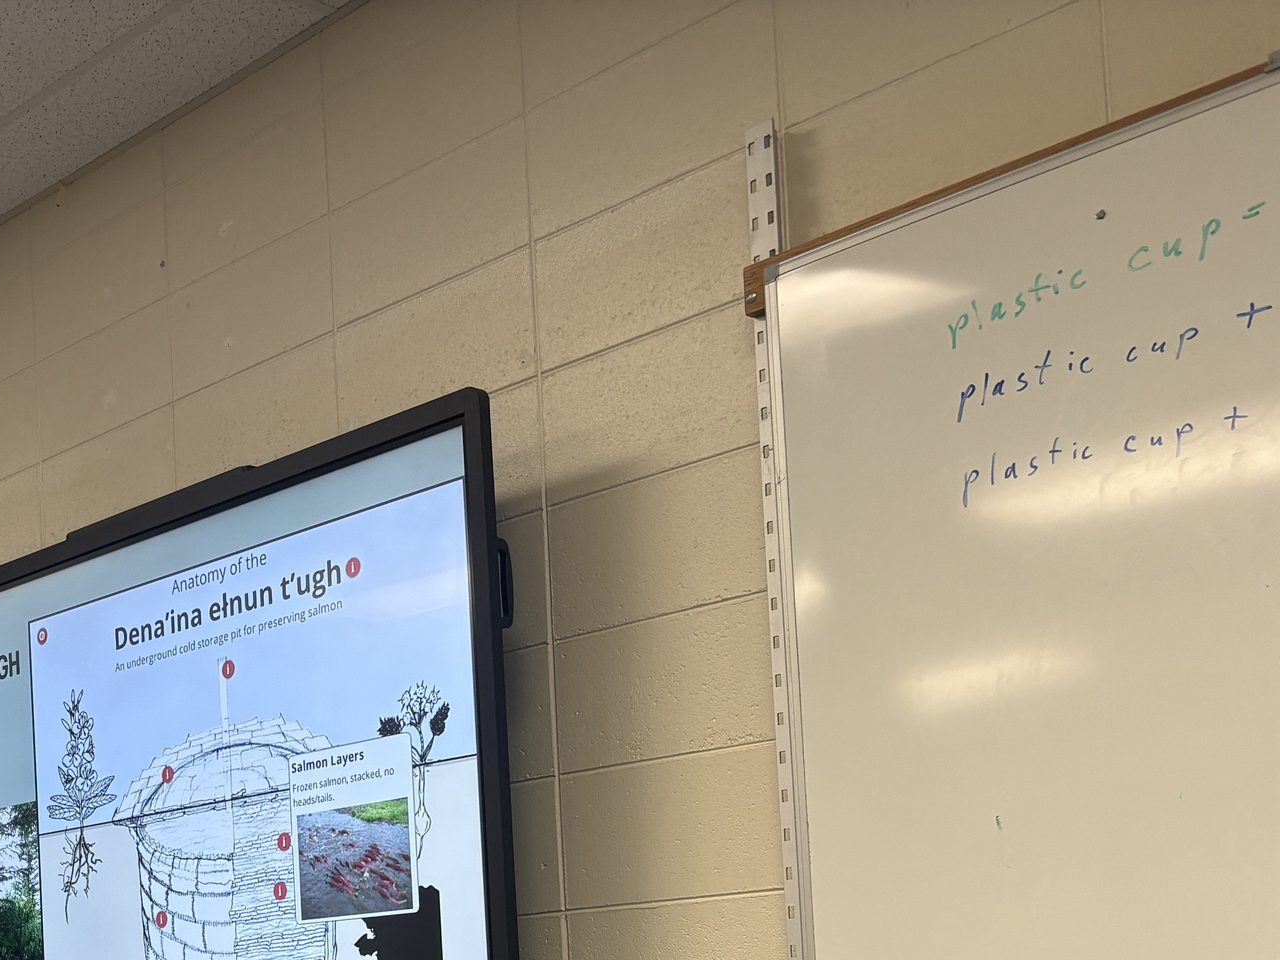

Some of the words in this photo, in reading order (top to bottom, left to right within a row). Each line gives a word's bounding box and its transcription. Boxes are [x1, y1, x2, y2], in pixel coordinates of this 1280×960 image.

[948, 269, 1087, 349] plastic
[1127, 217, 1221, 271] cup
[957, 350, 1094, 423] plastic
[1126, 327, 1199, 360] cup
[1236, 302, 1273, 328] +
[962, 436, 1093, 508] plastic
[1123, 422, 1194, 457] cup
[1223, 406, 1249, 430] +
[114, 606, 202, 650] Dena'ina
[208, 585, 273, 622] ełnun
[280, 559, 342, 600] t'ugh
[171, 565, 227, 595] Anatomy
[229, 557, 244, 576] of
[245, 552, 267, 571] the
[114, 662, 125, 672] An
[126, 646, 178, 666] underground
[179, 641, 196, 654] cold
[197, 633, 229, 649] storage
[230, 628, 242, 644] pit
[243, 623, 256, 637] for
[258, 610, 306, 635] preserving
[308, 599, 343, 617] salmon
[291, 758, 328, 774] Salmon
[331, 751, 365, 767] Layers
[292, 781, 318, 793] Frozen
[319, 776, 349, 789] salmon,
[350, 768, 383, 783] stacked,
[384, 767, 395, 777] no
[293, 793, 335, 807] heads/tails.
